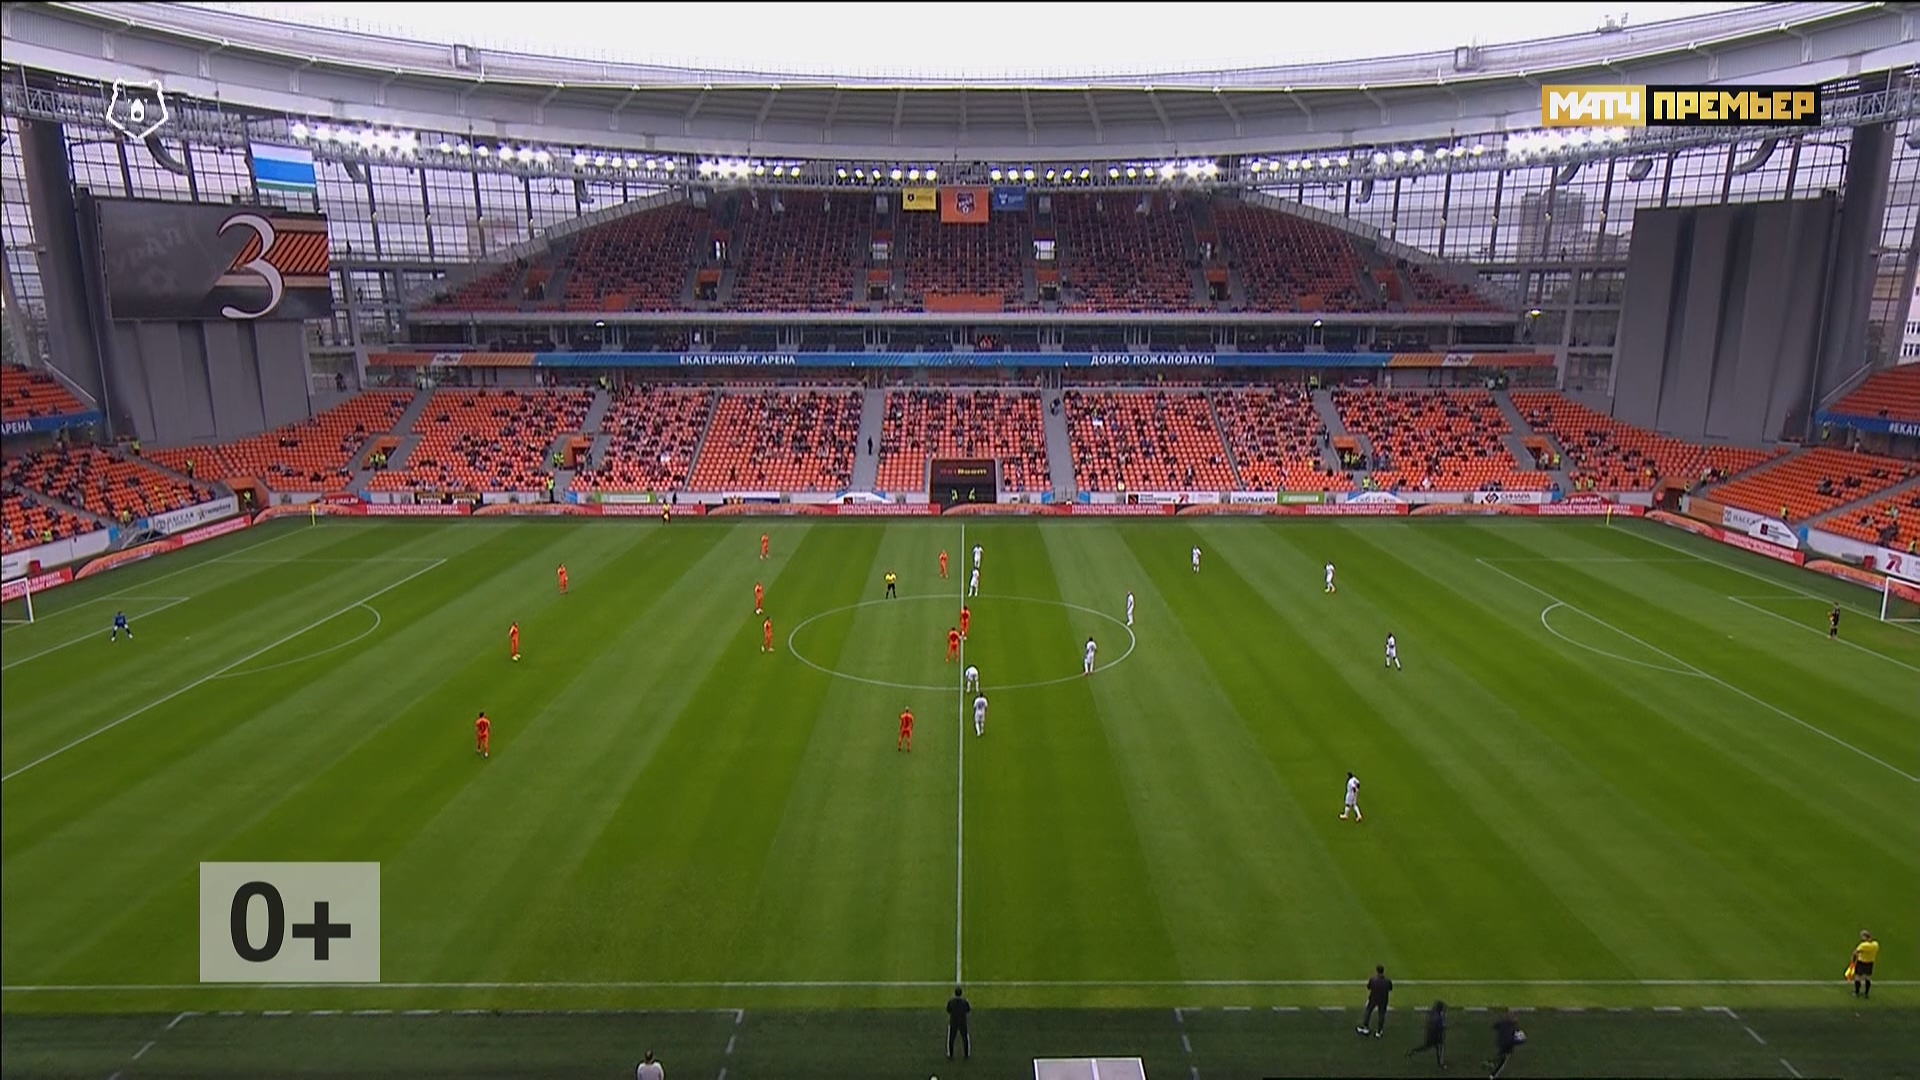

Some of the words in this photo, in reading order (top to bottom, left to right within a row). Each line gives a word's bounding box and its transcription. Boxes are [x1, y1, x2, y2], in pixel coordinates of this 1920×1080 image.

[216, 211, 285, 319] 3
[679, 354, 759, 366] ЕКАТЕРИНБУРГ
[761, 354, 796, 365] АРЕНА
[1090, 355, 1130, 367] ДОБРО
[1132, 354, 1215, 366] ПОЖАЛОВАТЬ!
